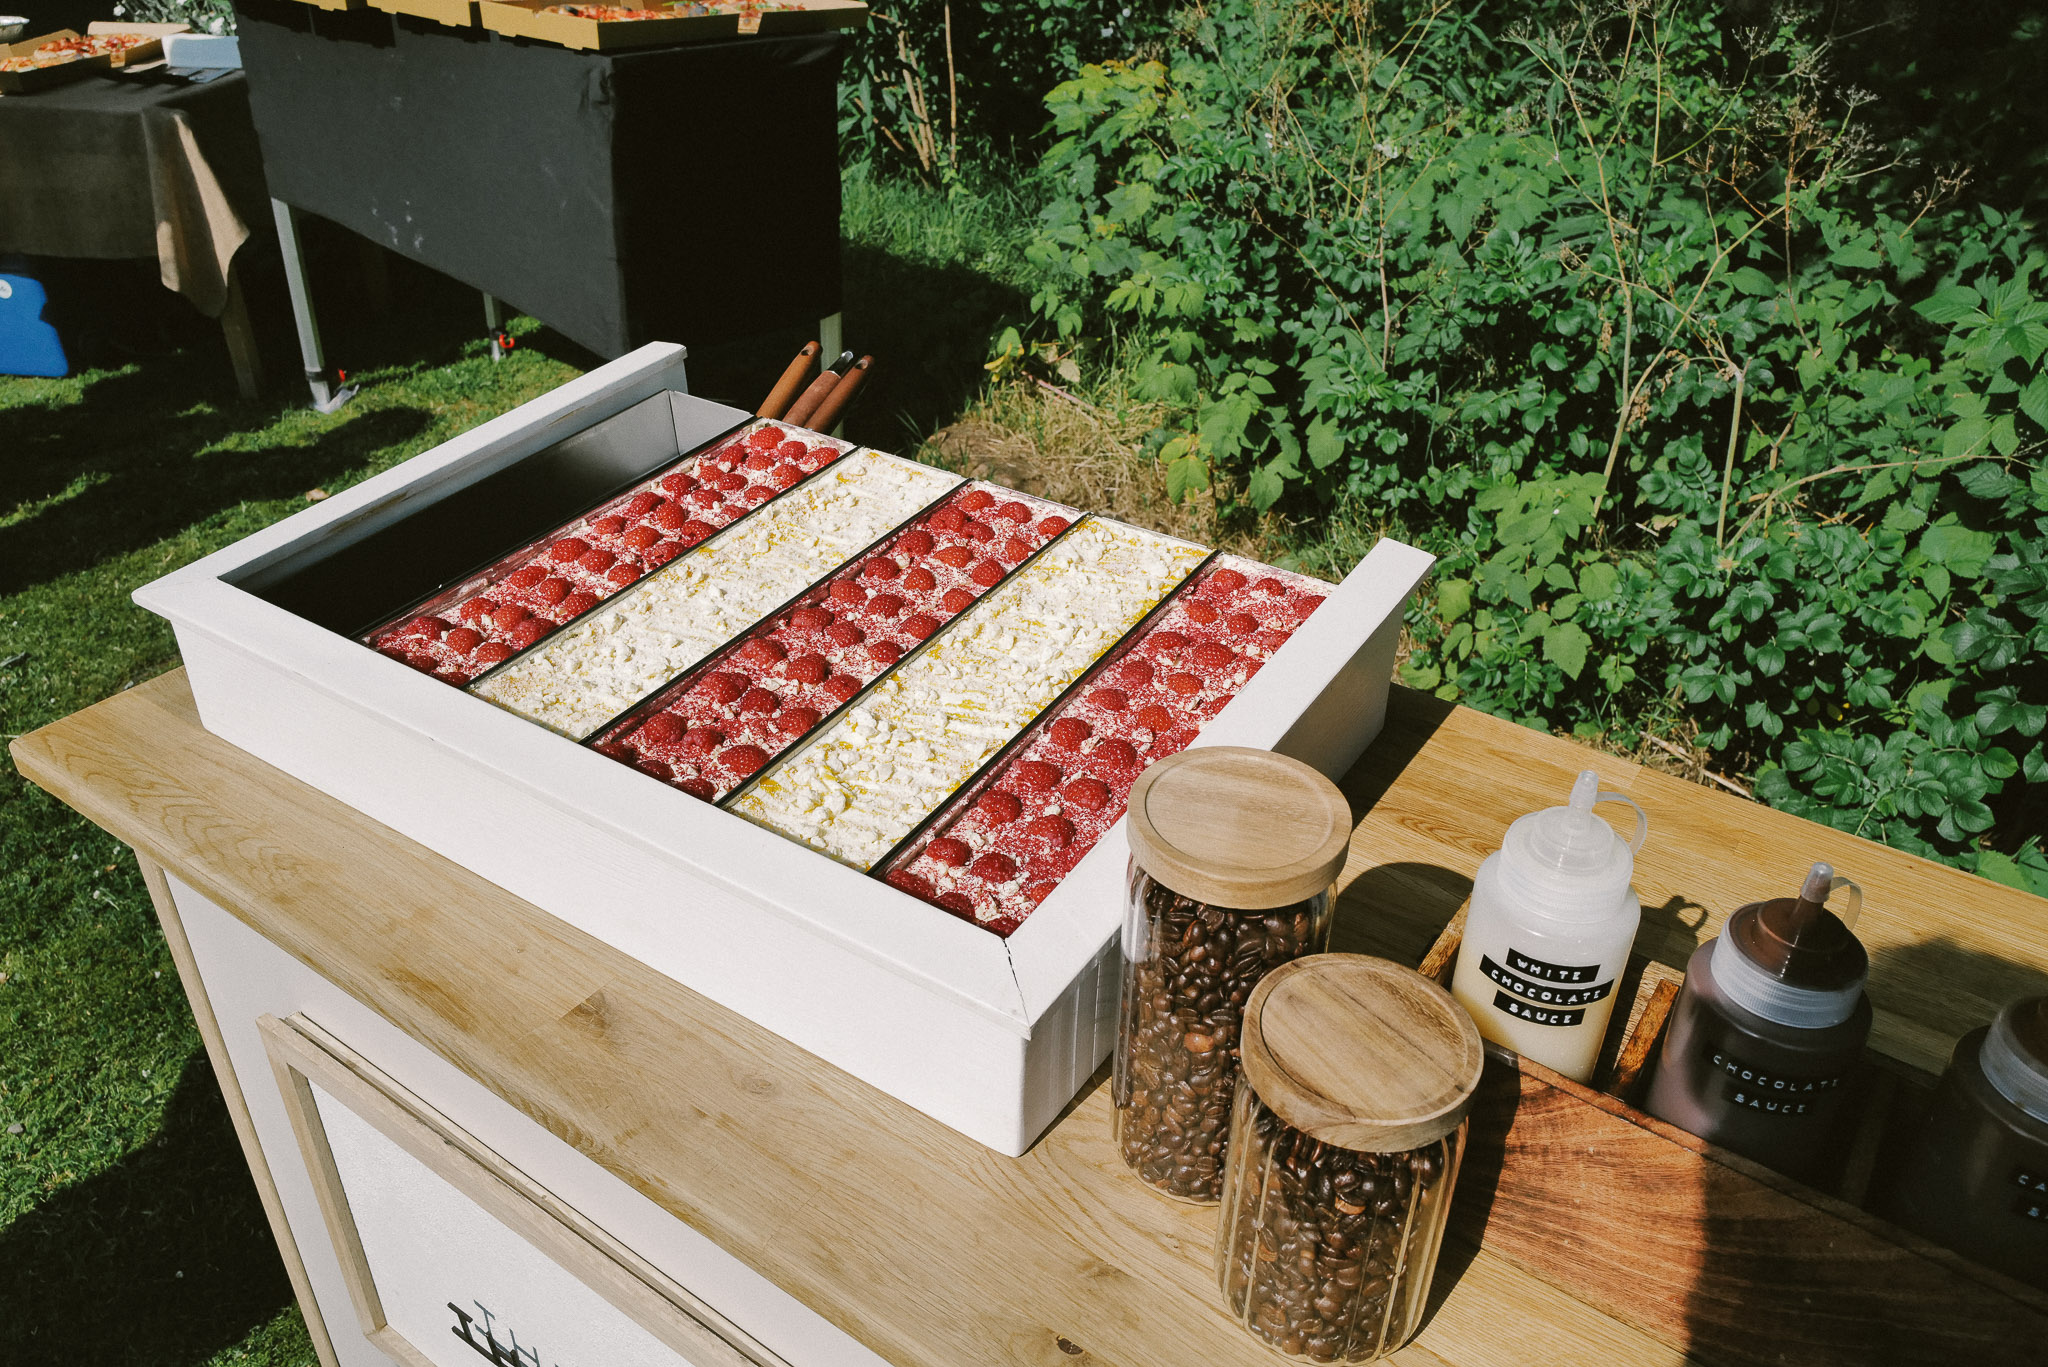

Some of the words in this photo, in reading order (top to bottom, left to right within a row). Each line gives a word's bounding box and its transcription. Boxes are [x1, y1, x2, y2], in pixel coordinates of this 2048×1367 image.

[1516, 958, 1582, 981] WHITE
[1491, 969, 1601, 1005] CHOCOLATE
[1508, 1002, 1573, 1024] SAUCE
[1713, 1054, 1839, 1091] CHOCOLATE
[1734, 1093, 1806, 1113] SAUCE
